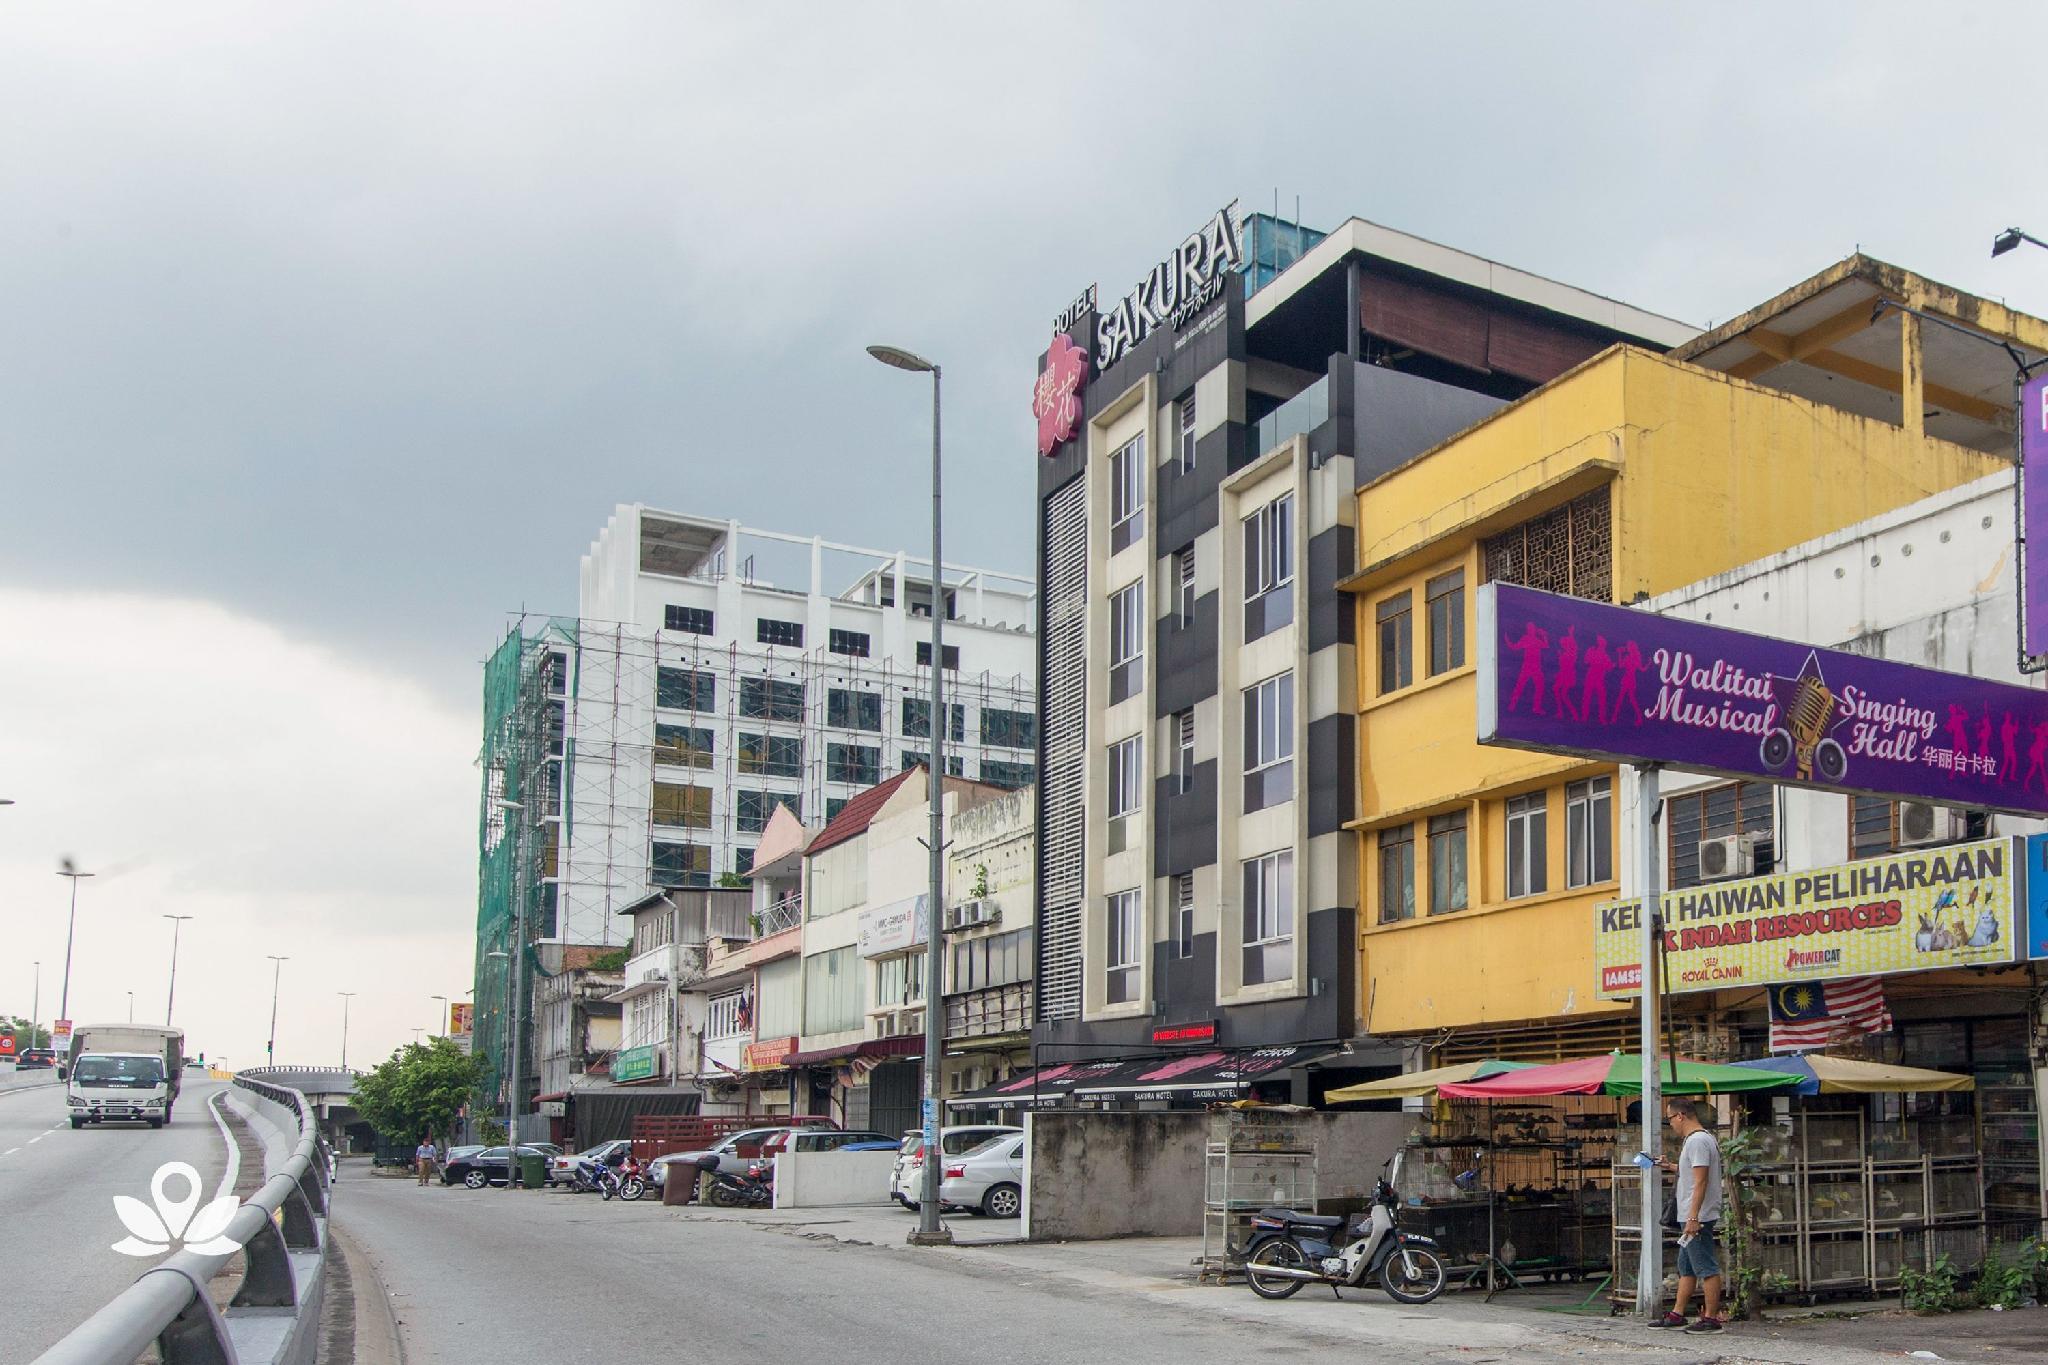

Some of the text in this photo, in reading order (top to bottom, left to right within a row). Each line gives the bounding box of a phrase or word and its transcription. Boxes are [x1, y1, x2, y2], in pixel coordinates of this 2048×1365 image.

[1052, 288, 1095, 336] HOTEL
[1096, 208, 1238, 370] SAKURA
[1171, 273, 1223, 332] サクラホテル
[1653, 647, 1775, 702] Walitai
[1643, 688, 1777, 738] Musical
[1838, 684, 1938, 740] Singing
[1849, 723, 1918, 763] Hall
[1921, 745, 1997, 776] 华丽台卡拉
[1602, 899, 1671, 932] KEI
[1679, 879, 1787, 922] HAIWAN
[1794, 846, 2004, 904] PELIHARAAN
[1681, 921, 1752, 949] INDAH
[1756, 899, 1903, 941] RESOURCES
[1605, 969, 1636, 987] IAMS
[1682, 968, 1710, 983] ROYAL
[1793, 949, 1841, 967] POWERCAT
[1134, 1092, 1174, 1101] SAKURA HOTEL
[1193, 1089, 1217, 1098] SAKURA
